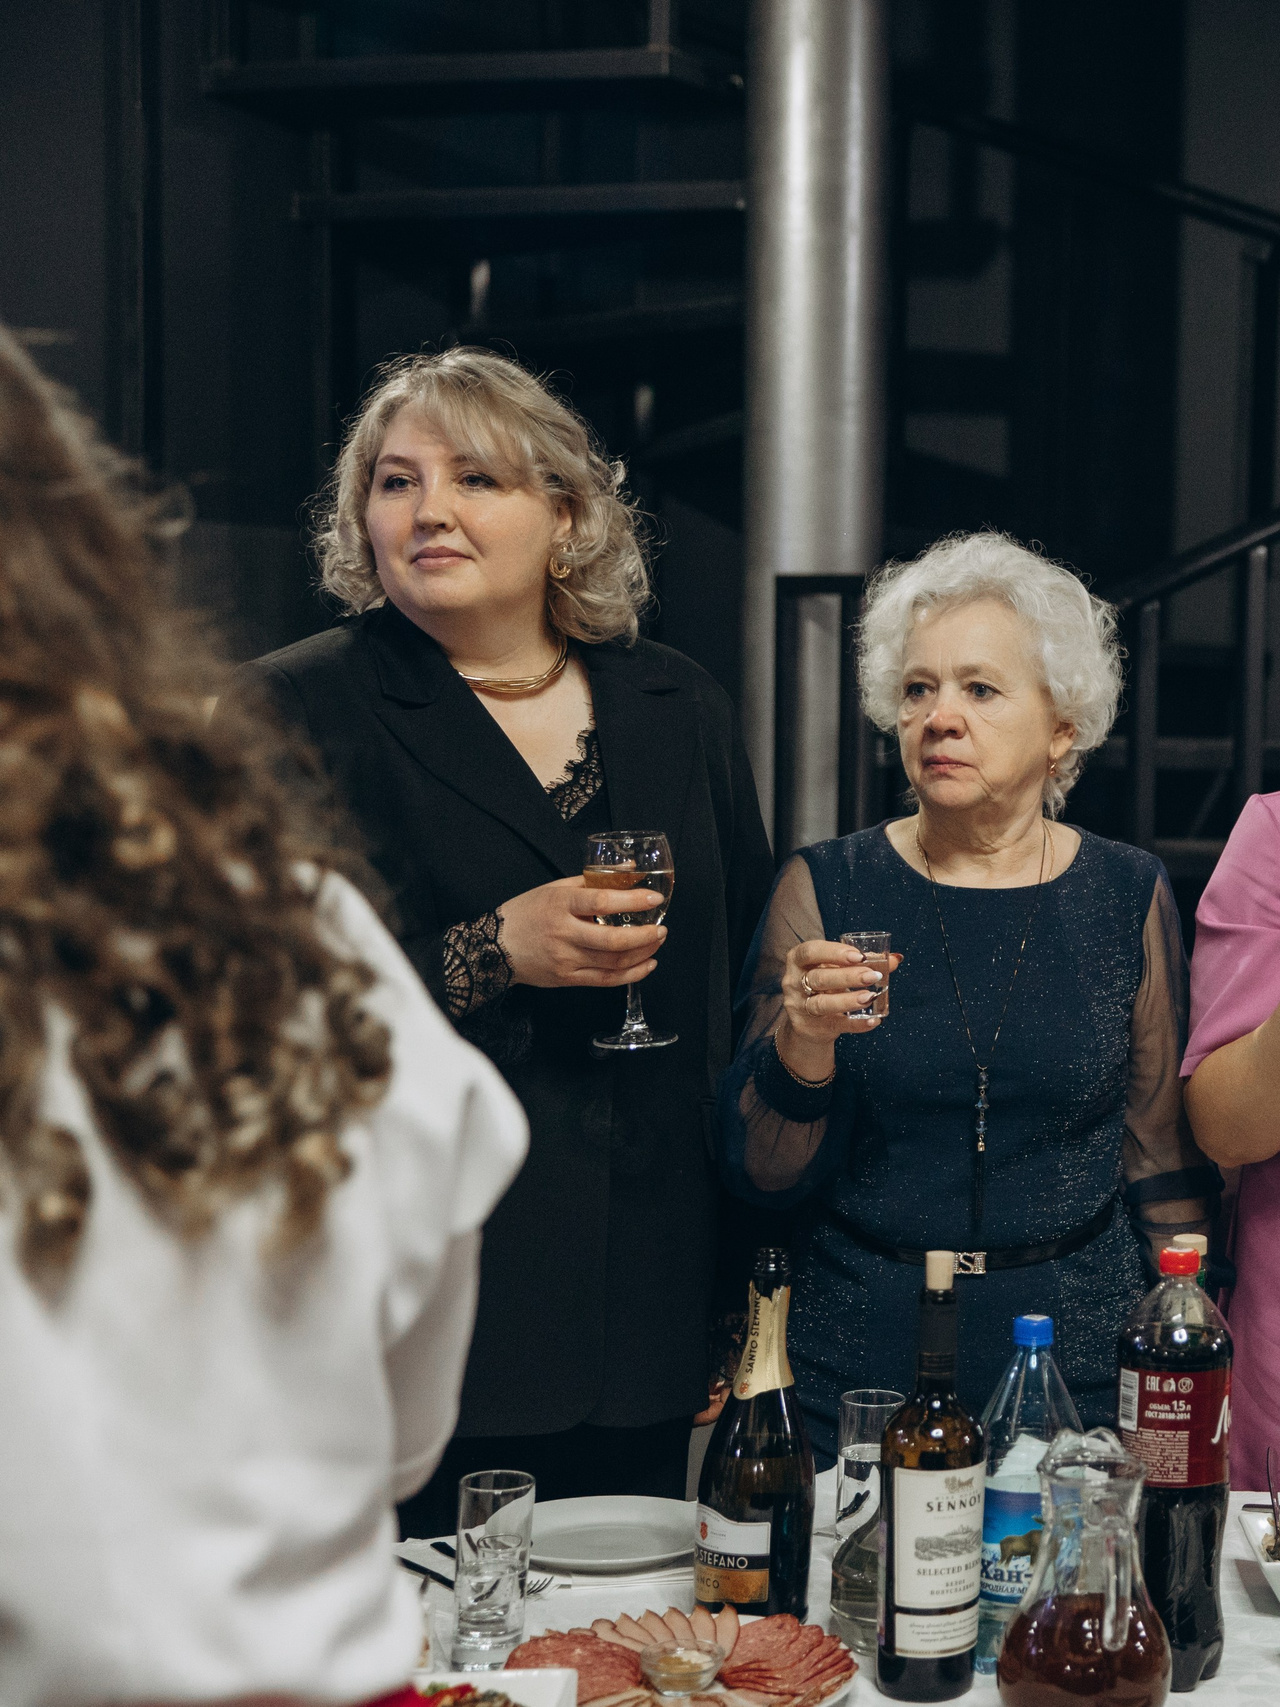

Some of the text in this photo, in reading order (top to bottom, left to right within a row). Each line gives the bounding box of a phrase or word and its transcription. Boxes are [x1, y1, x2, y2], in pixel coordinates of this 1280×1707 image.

[745, 1292, 761, 1374] SANTO STEFANO
[1145, 1410, 1158, 1418] ГОСТ
[699, 1549, 748, 1569] STEFANO
[917, 1565, 962, 1577] SELECTED
